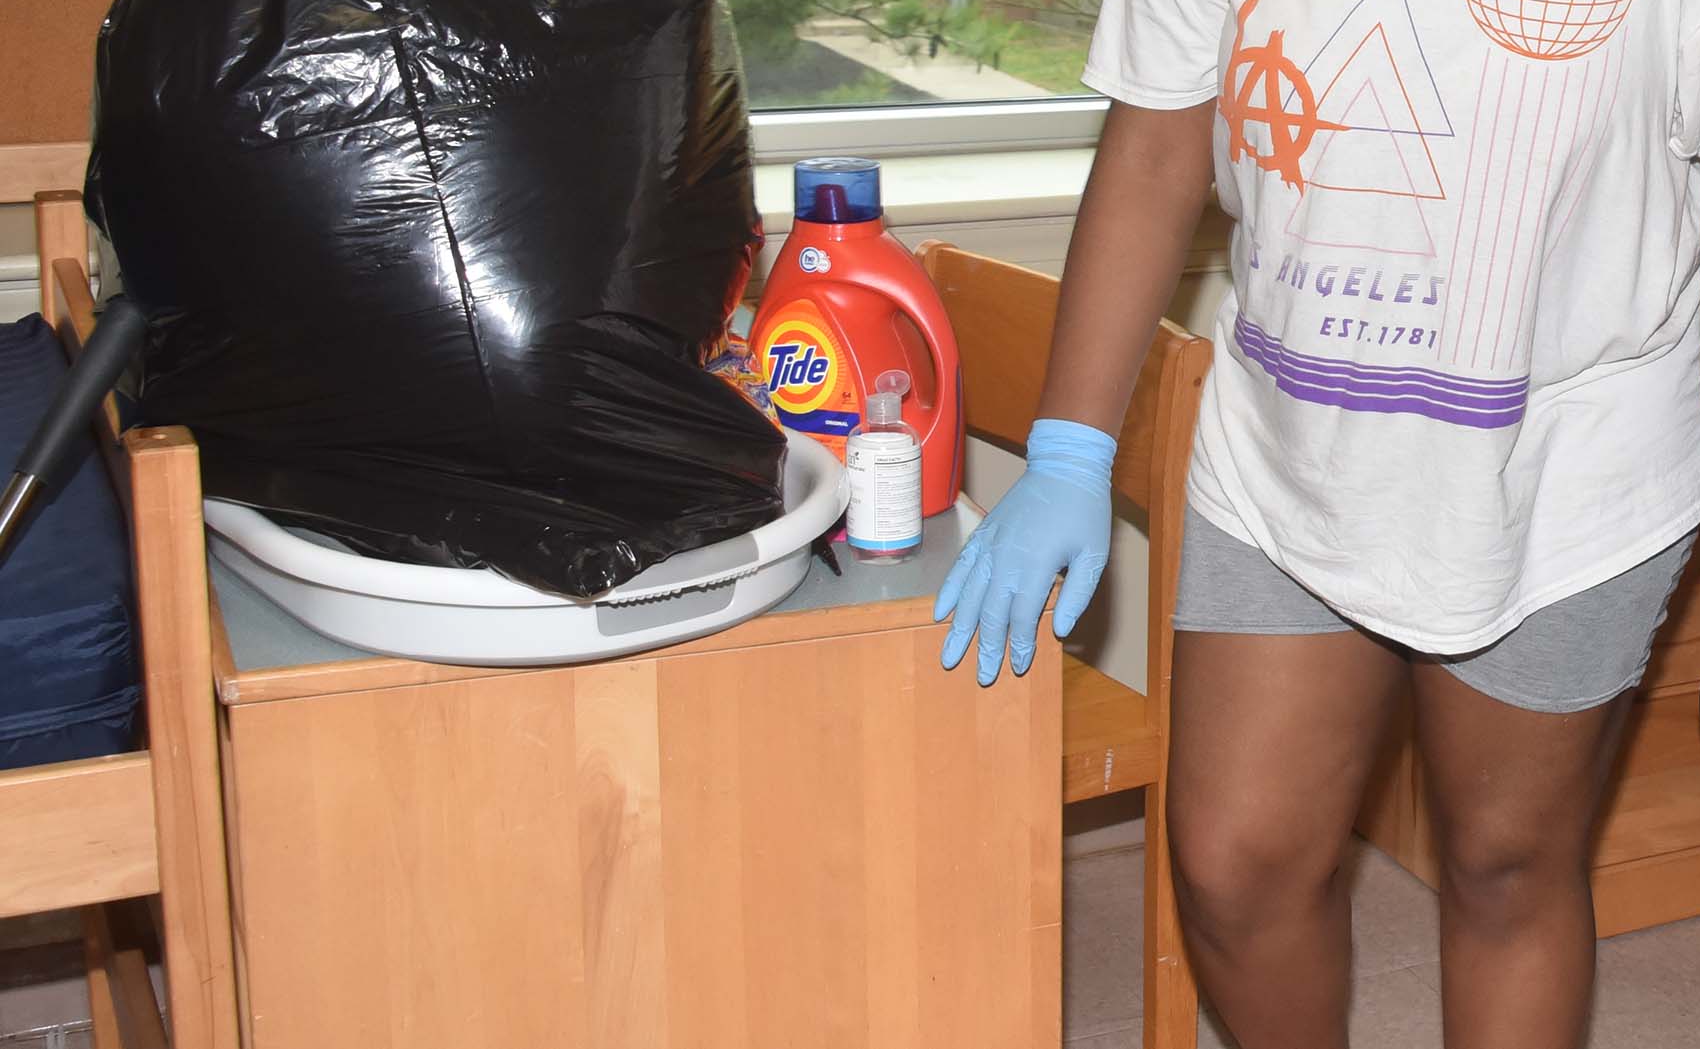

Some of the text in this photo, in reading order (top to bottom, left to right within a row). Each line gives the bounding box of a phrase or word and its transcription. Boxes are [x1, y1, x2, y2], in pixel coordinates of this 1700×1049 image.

[1276, 254, 1445, 305] ANGELES
[1319, 316, 1437, 349] EST.1781
[768, 343, 830, 393] Tide
